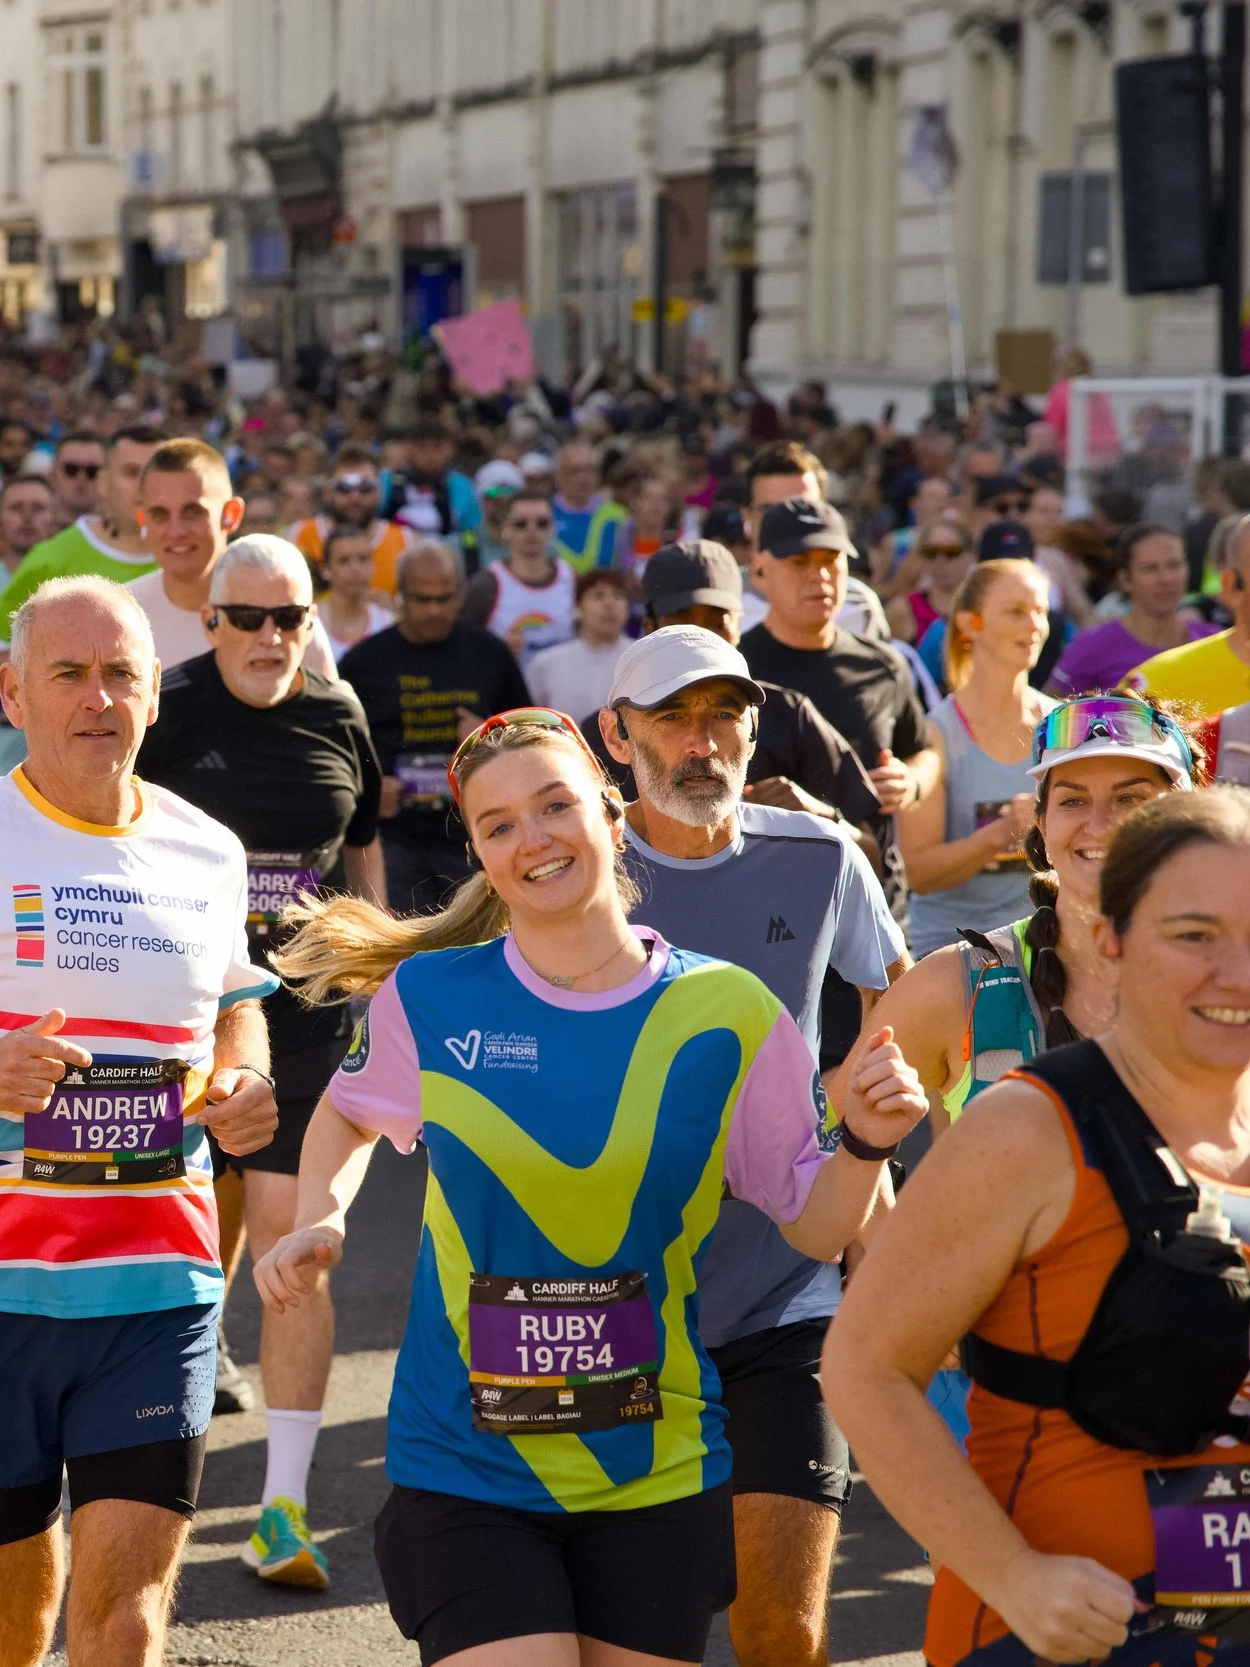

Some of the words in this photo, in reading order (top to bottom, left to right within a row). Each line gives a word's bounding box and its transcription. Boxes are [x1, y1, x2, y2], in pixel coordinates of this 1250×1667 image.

[51, 884, 145, 905] ymchwil
[147, 892, 209, 915] canser
[55, 906, 123, 926] cymru
[57, 929, 129, 949] cancer
[132, 935, 207, 958] research
[57, 952, 119, 973] wales
[484, 1046, 538, 1056] VELINDRE
[90, 1067, 137, 1078] CARDIFF
[140, 1065, 163, 1077] HALF
[483, 1059, 538, 1073] Fundraising
[52, 1093, 168, 1120] ANDREW
[71, 1124, 155, 1149] 19237
[135, 1152, 155, 1160] UNISEX
[156, 1149, 170, 1157] LARGE
[532, 1282, 587, 1295] CARDIFF
[589, 1279, 619, 1294] HALF
[520, 1313, 607, 1342] RUBY
[516, 1343, 614, 1373] 19754
[494, 1376, 520, 1385] PURPLE
[588, 1374, 613, 1382] UNISEX
[614, 1367, 639, 1379] MEDIUM
[482, 1411, 507, 1420] BAGGAGE
[508, 1413, 530, 1421] LABEL
[556, 1411, 581, 1420] BAGIAU
[619, 1402, 654, 1417] 19754
